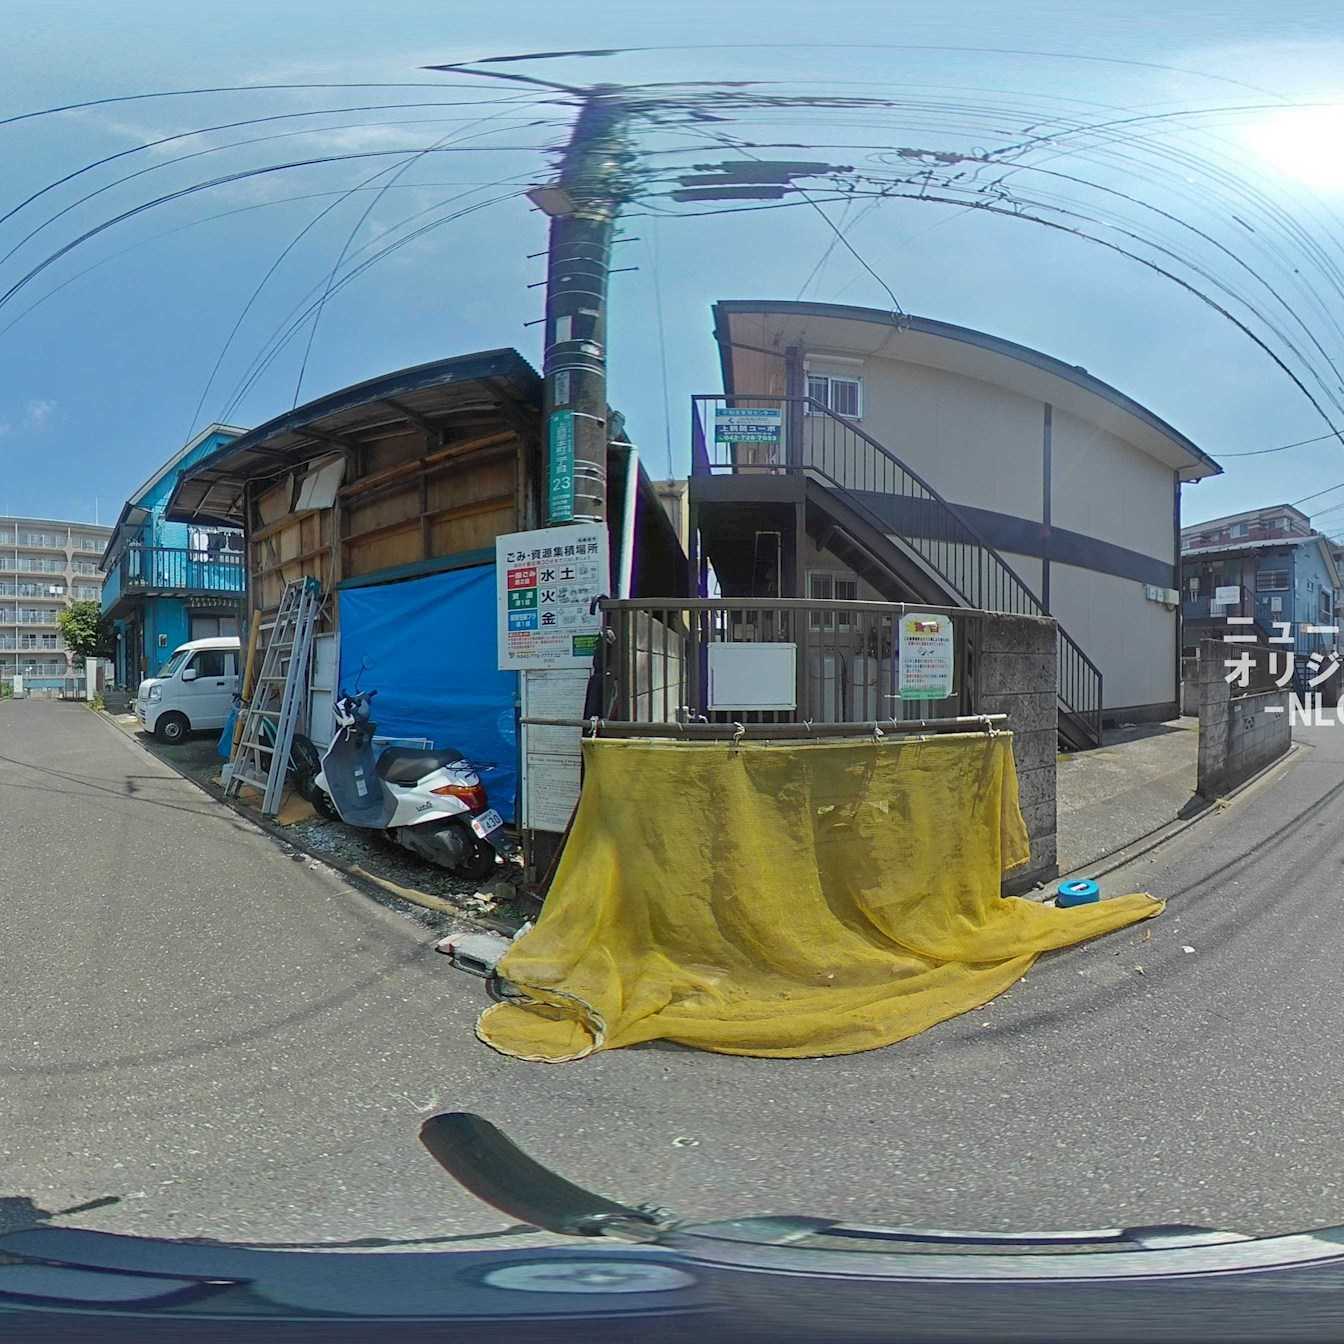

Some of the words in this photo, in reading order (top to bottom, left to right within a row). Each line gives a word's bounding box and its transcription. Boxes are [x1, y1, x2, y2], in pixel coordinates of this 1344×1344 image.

[553, 476, 571, 491] 23
[541, 569, 555, 582] 水
[560, 567, 575, 580] 土
[541, 590, 555, 603] 火
[541, 612, 556, 626] 金
